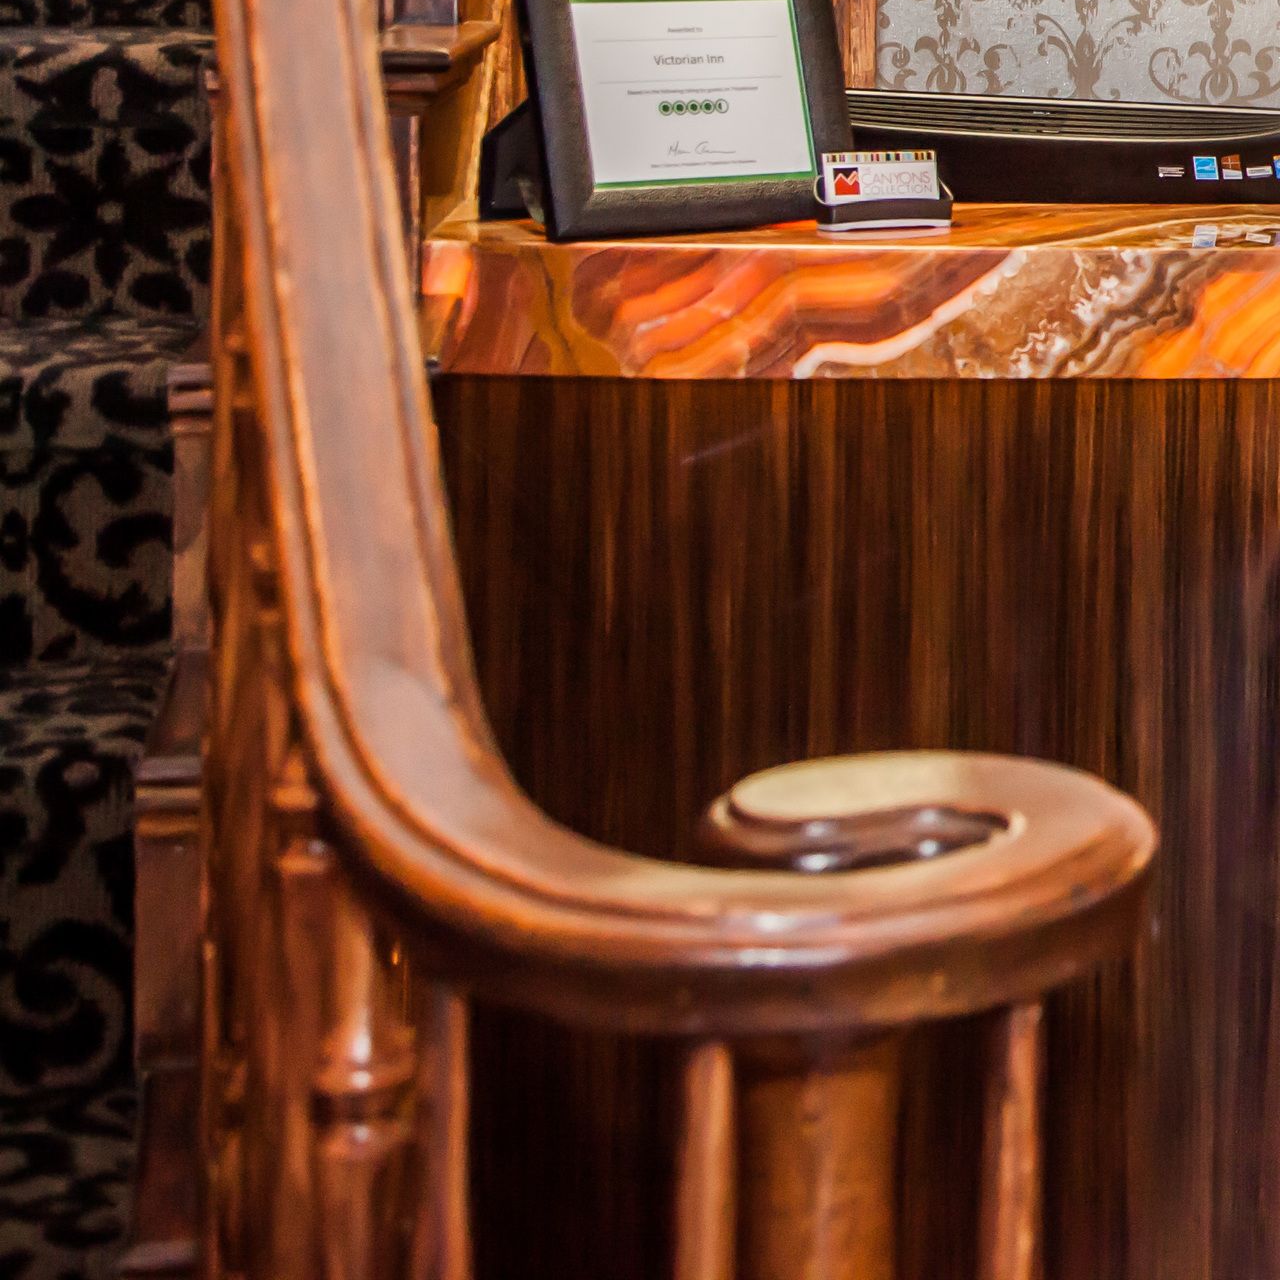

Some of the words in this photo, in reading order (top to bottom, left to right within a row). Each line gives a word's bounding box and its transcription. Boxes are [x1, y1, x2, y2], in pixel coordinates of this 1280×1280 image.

[653, 54, 703, 66] Victorian
[707, 54, 724, 64] Inn
[861, 171, 931, 186] CANYONS
[863, 184, 933, 196] COLLECTION
